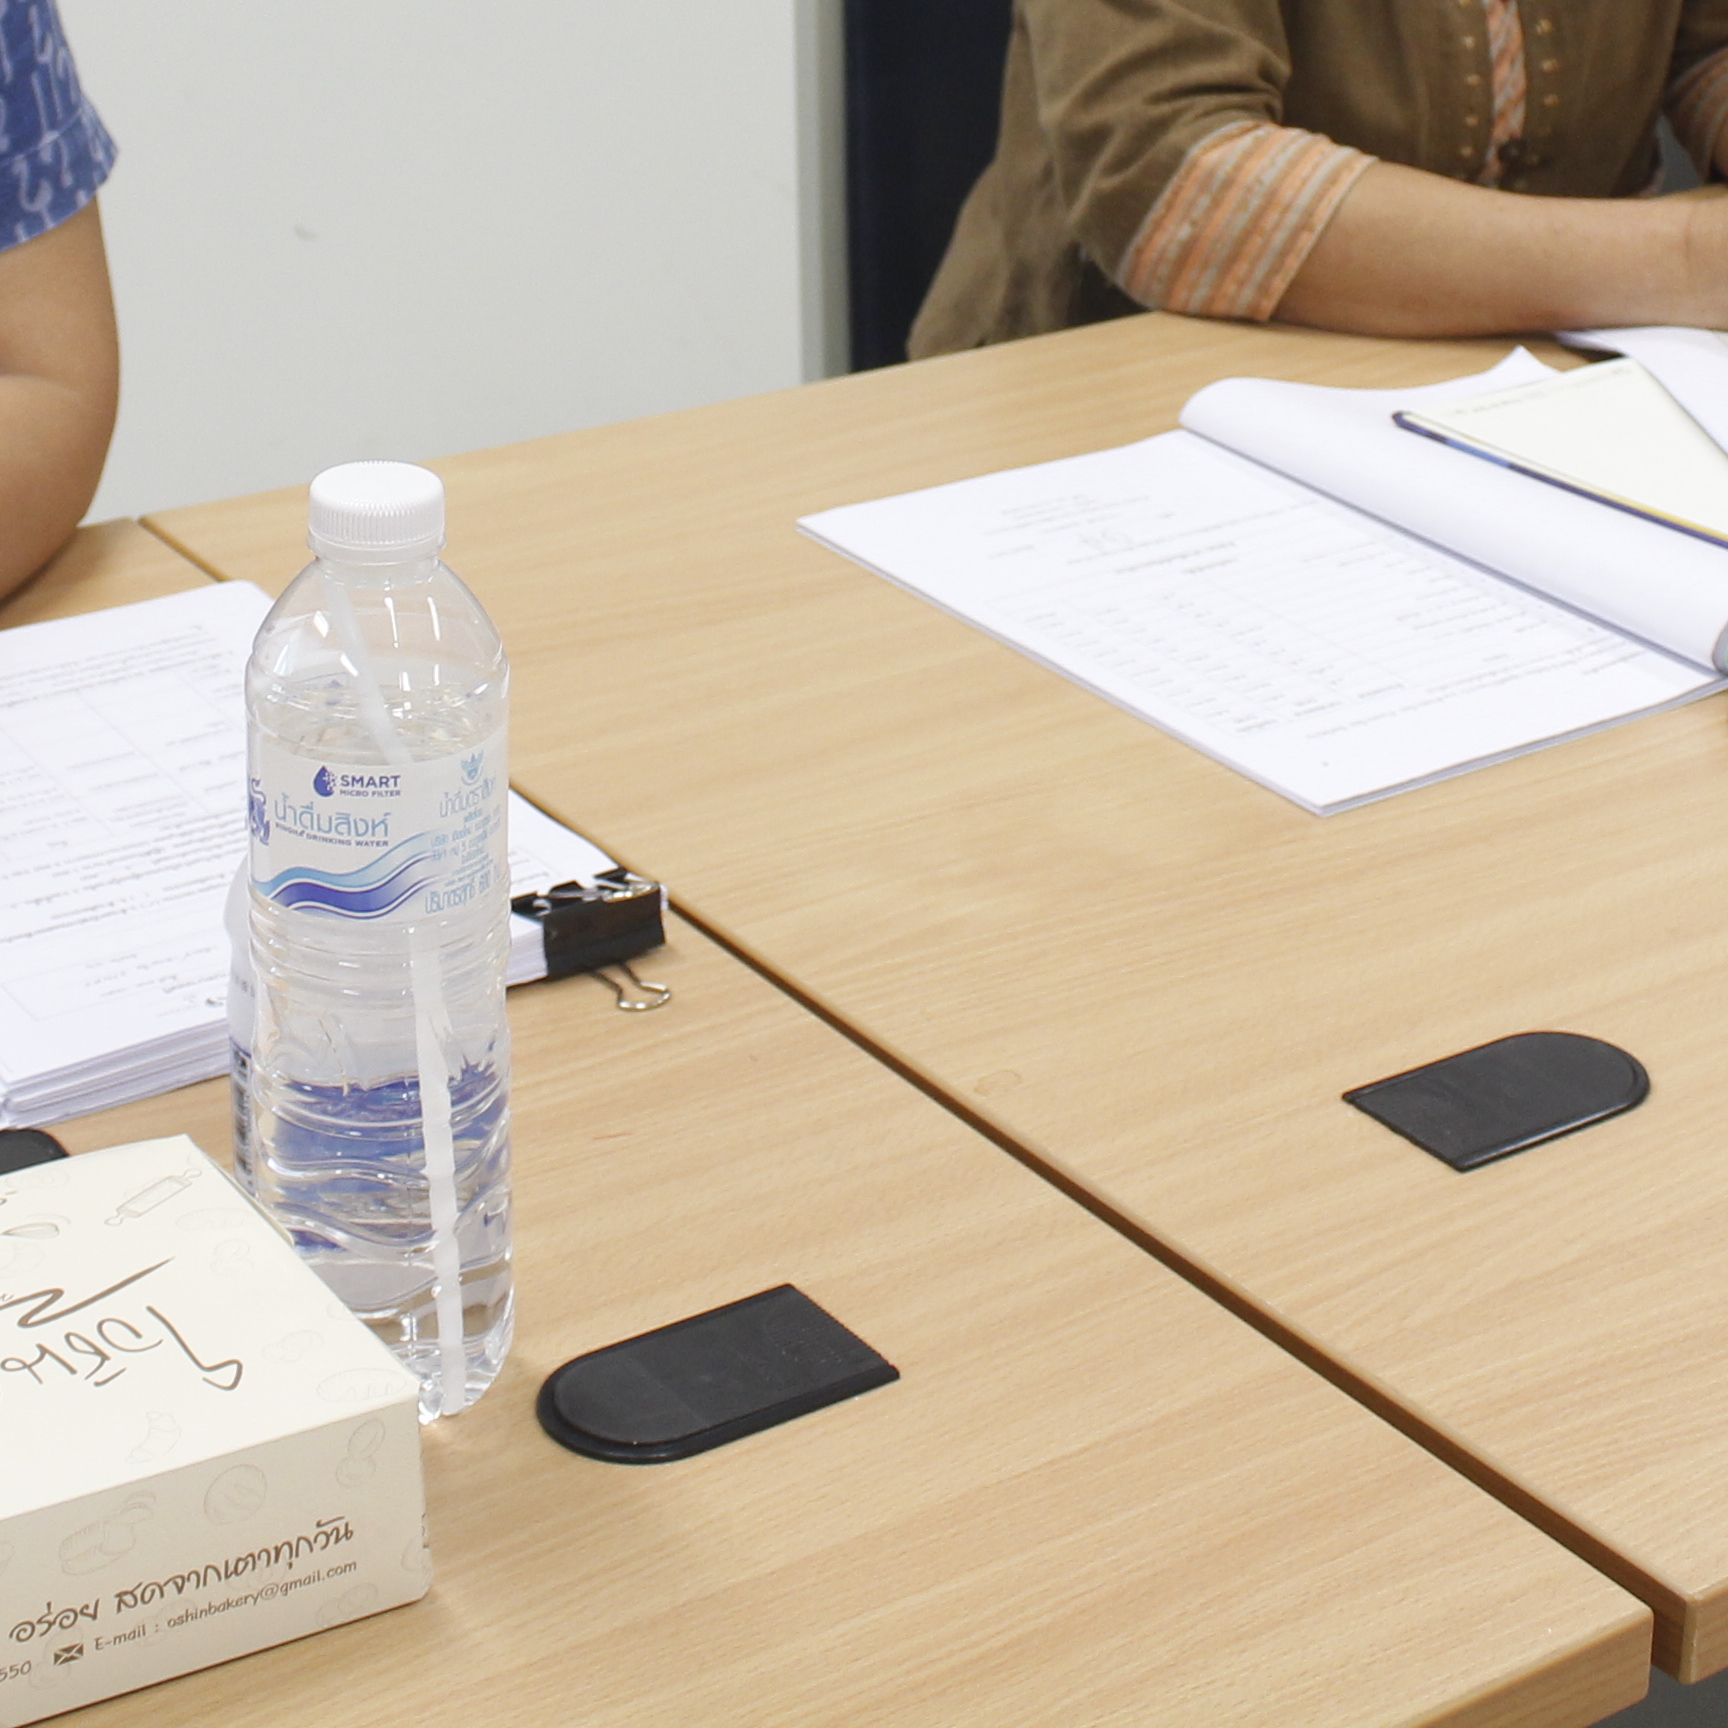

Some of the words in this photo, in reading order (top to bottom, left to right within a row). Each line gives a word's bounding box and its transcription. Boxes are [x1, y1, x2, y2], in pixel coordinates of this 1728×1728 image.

[340, 775, 401, 788] SMART
[274, 794, 392, 838] น้ำดื่มสิงห์
[306, 833, 352, 847] DRINKING
[355, 839, 389, 847] WATER
[9, 1598, 100, 1644] อร่อย
[114, 1515, 354, 1616] สดจากเตาทุกวัน
[94, 1624, 147, 1652] E-mail
[166, 1559, 358, 1630] oshinbakery@gmail.com
